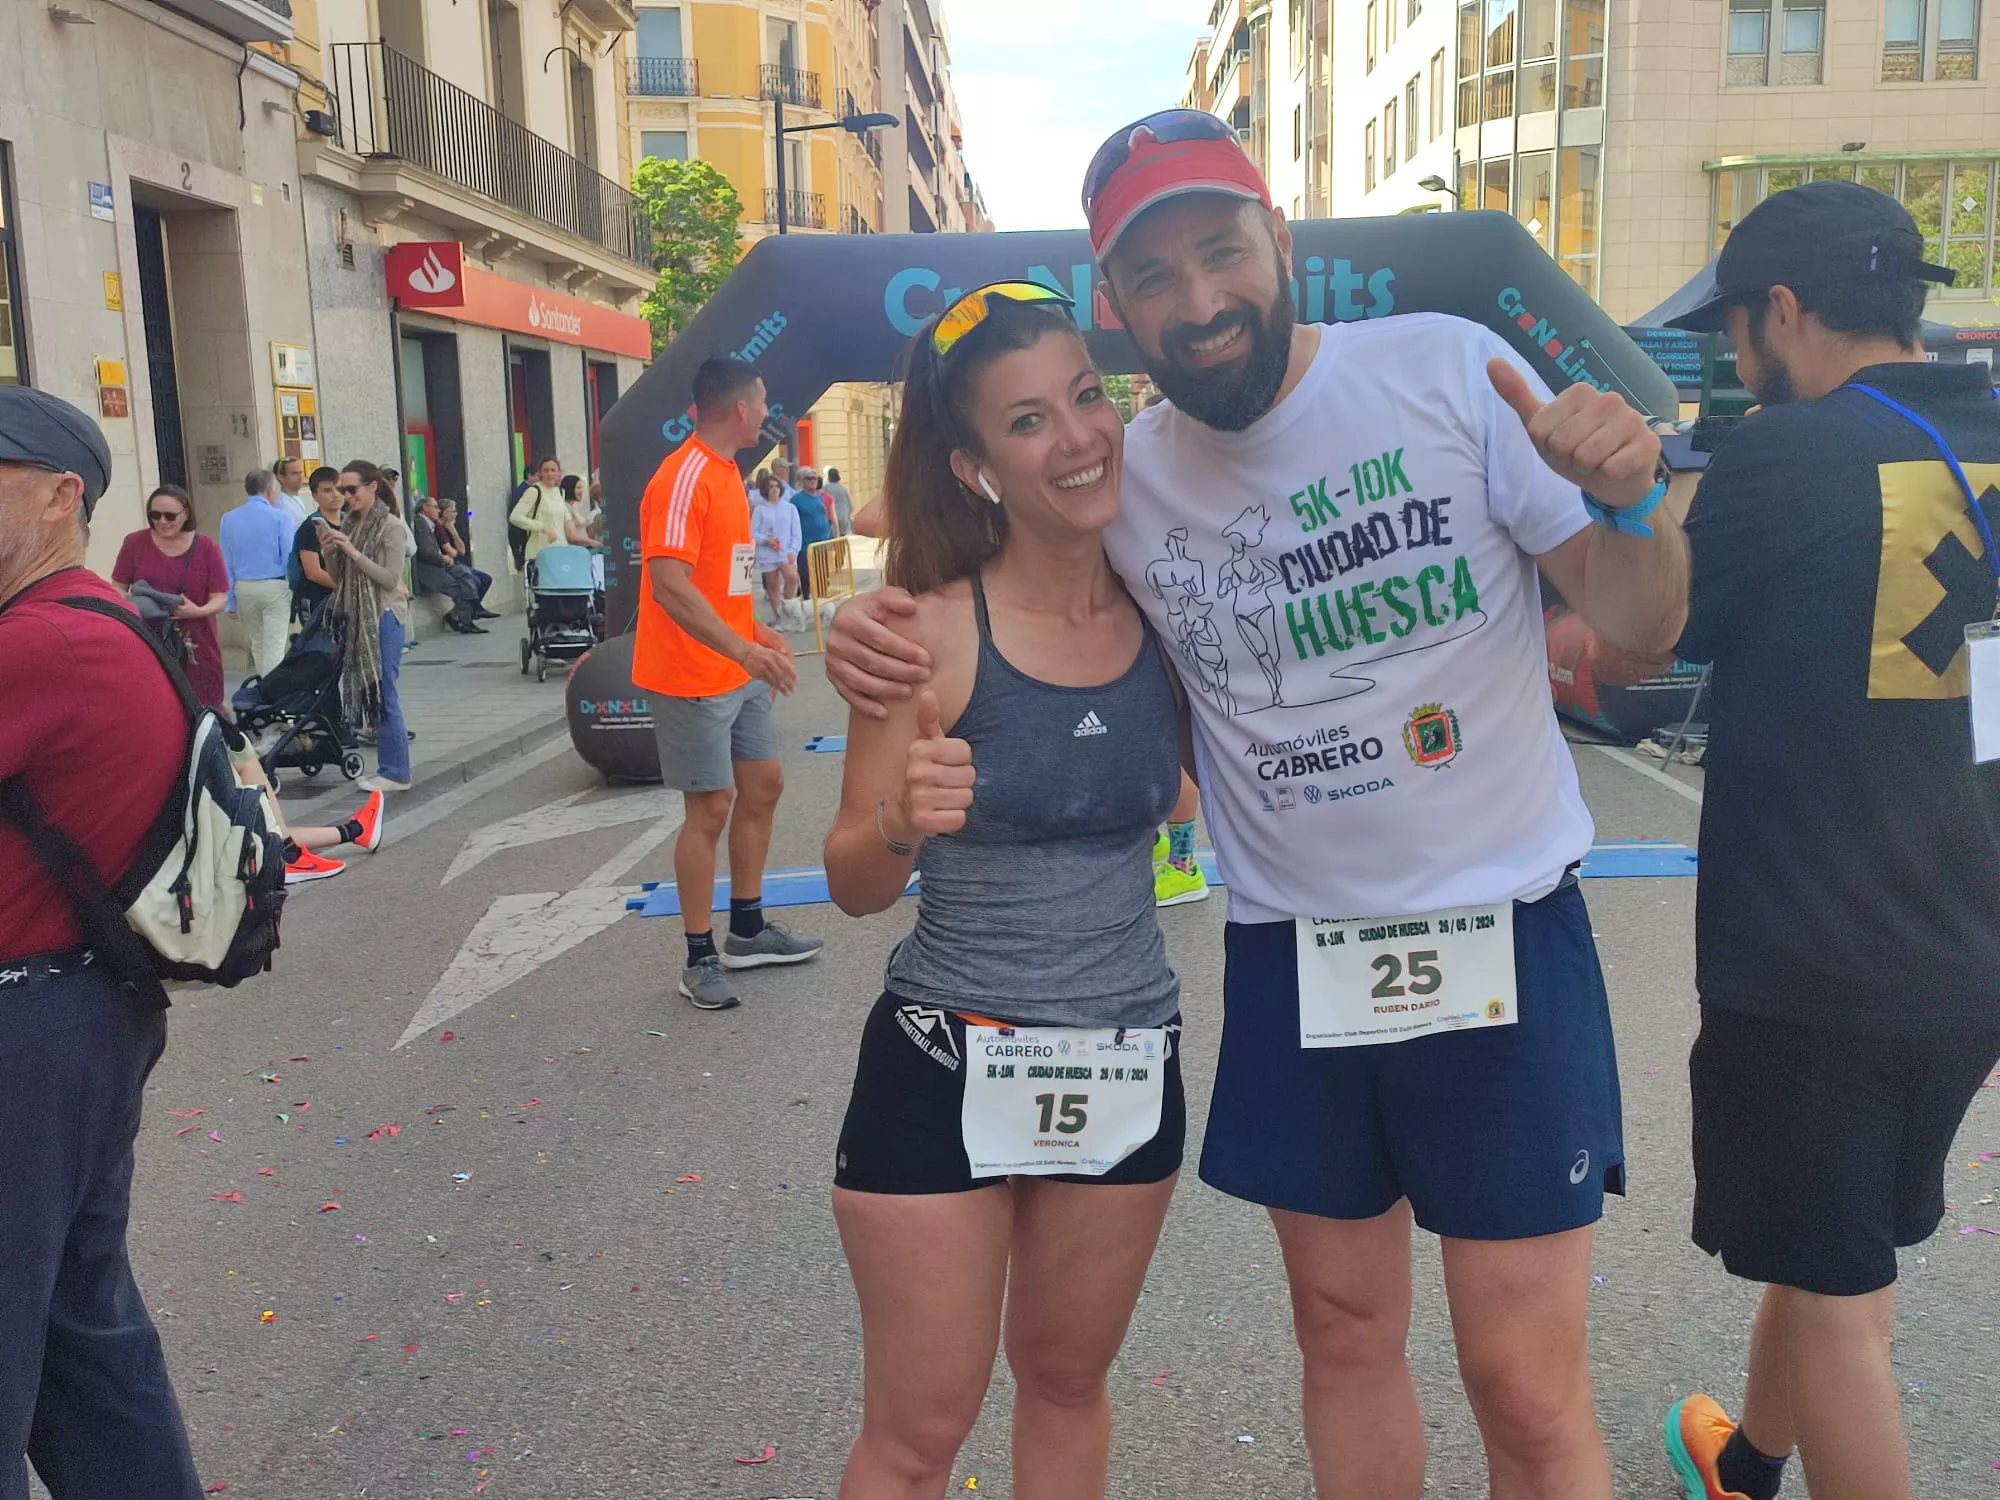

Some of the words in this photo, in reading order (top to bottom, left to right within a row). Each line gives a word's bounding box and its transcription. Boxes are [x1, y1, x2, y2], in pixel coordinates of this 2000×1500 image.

[181, 161, 193, 191] 2
[539, 301, 582, 336] Santander
[1289, 448, 1413, 533] 5K-10K
[1278, 511, 1399, 595] CIUDAD
[1398, 497, 1453, 550] DE
[1284, 555, 1481, 661] HUESCA
[1073, 725, 1108, 737] adidas
[1257, 736, 1384, 781] CABRERO
[1358, 926, 1387, 942] CIUDAD
[1387, 924, 1398, 938] DE
[1399, 921, 1430, 936] HUESCA
[1370, 950, 1443, 999] 25
[1373, 1004, 1409, 1014] RUBEN
[927, 1045, 960, 1071] ARGUIS
[985, 1044, 1054, 1058] CABRERO
[1027, 1065, 1054, 1079] CIUDAD
[1054, 1066, 1065, 1079] DE
[1065, 1066, 1093, 1080] HUESCA
[1035, 1093, 1089, 1134] 15
[1033, 1140, 1080, 1148] VERONICA
